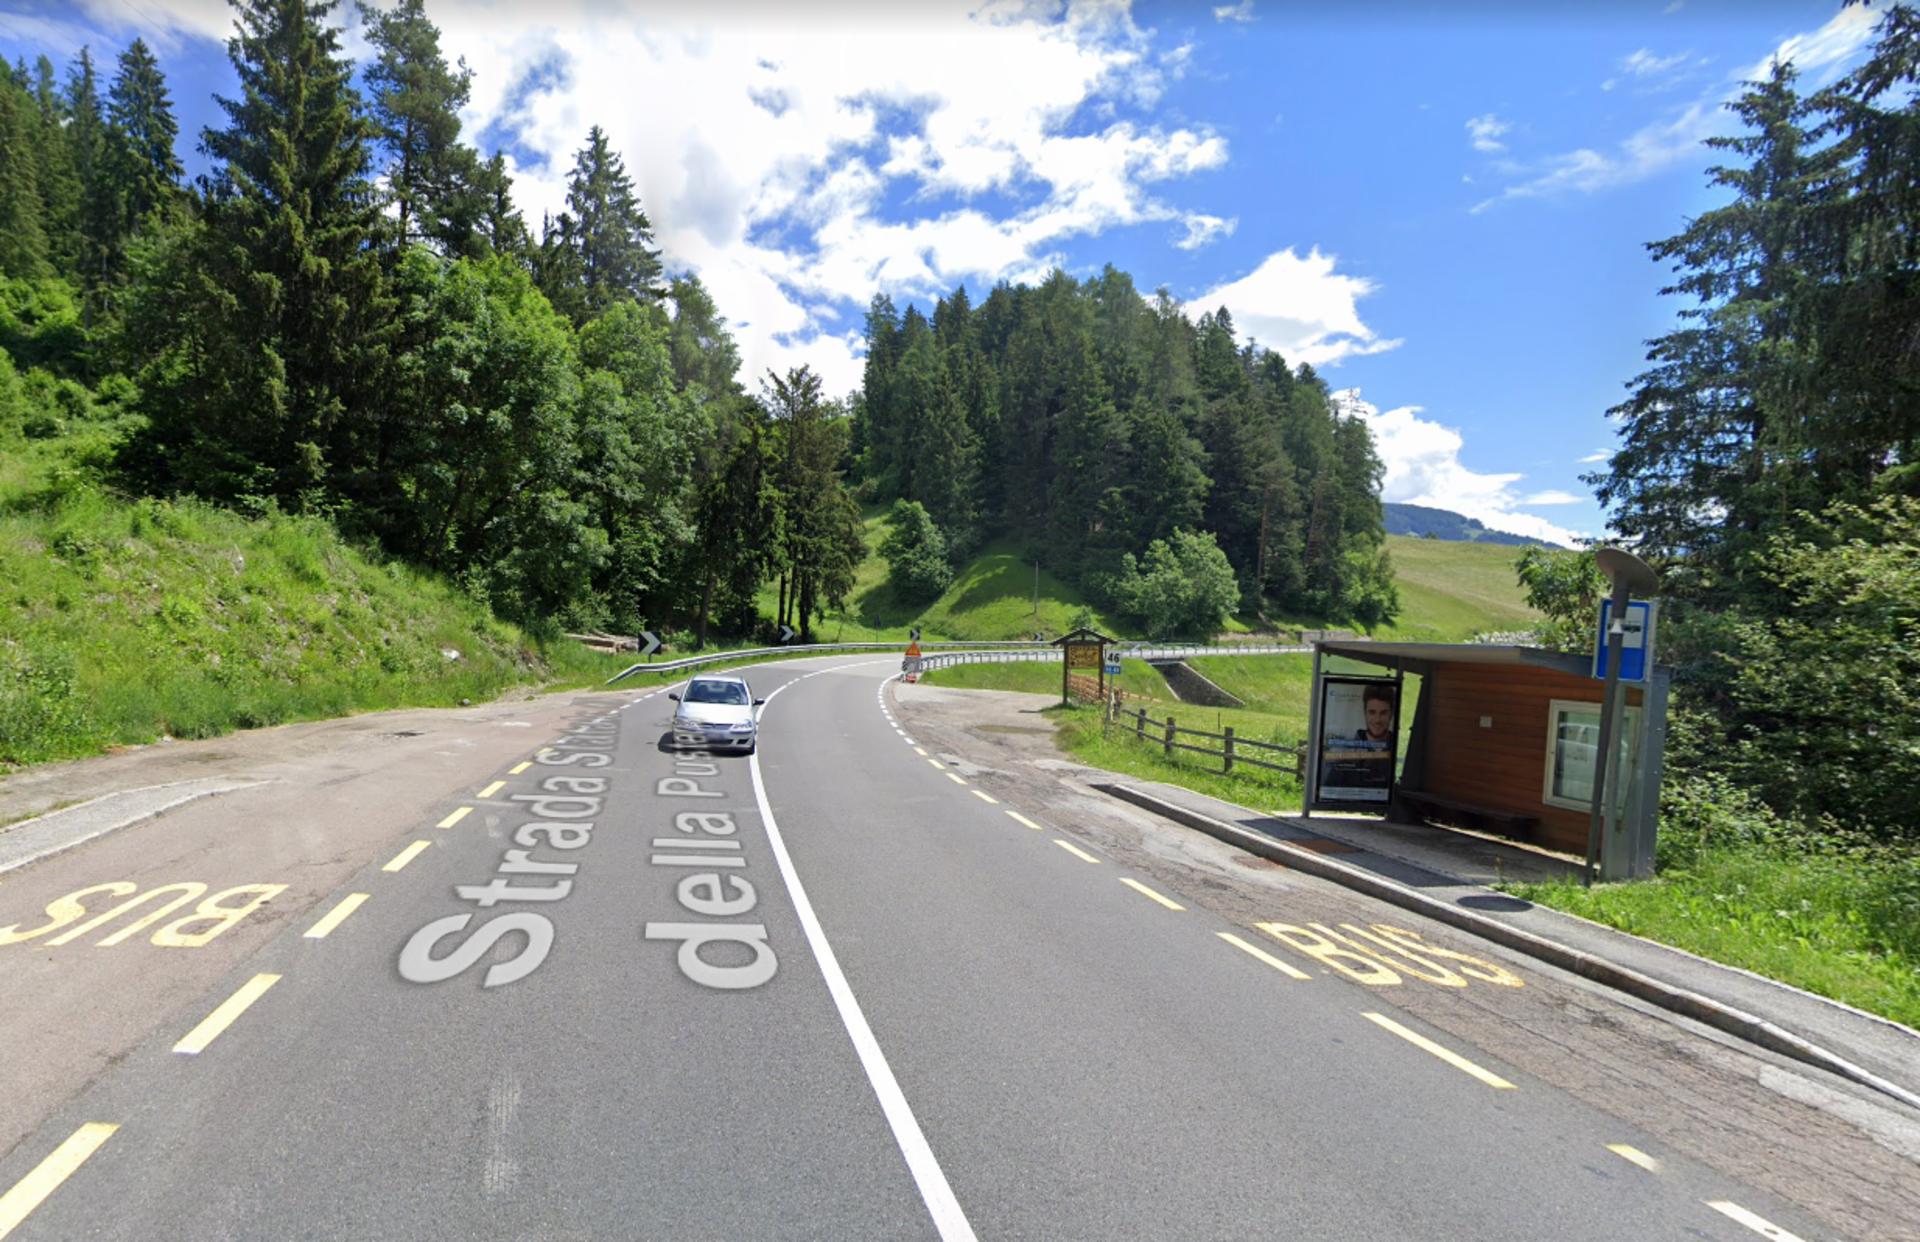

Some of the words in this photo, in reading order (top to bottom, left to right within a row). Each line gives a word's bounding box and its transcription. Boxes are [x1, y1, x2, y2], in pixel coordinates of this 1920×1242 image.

[1107, 652, 1120, 663] 46
[0, 881, 290, 947] BUS
[1253, 921, 1525, 988] BUS
